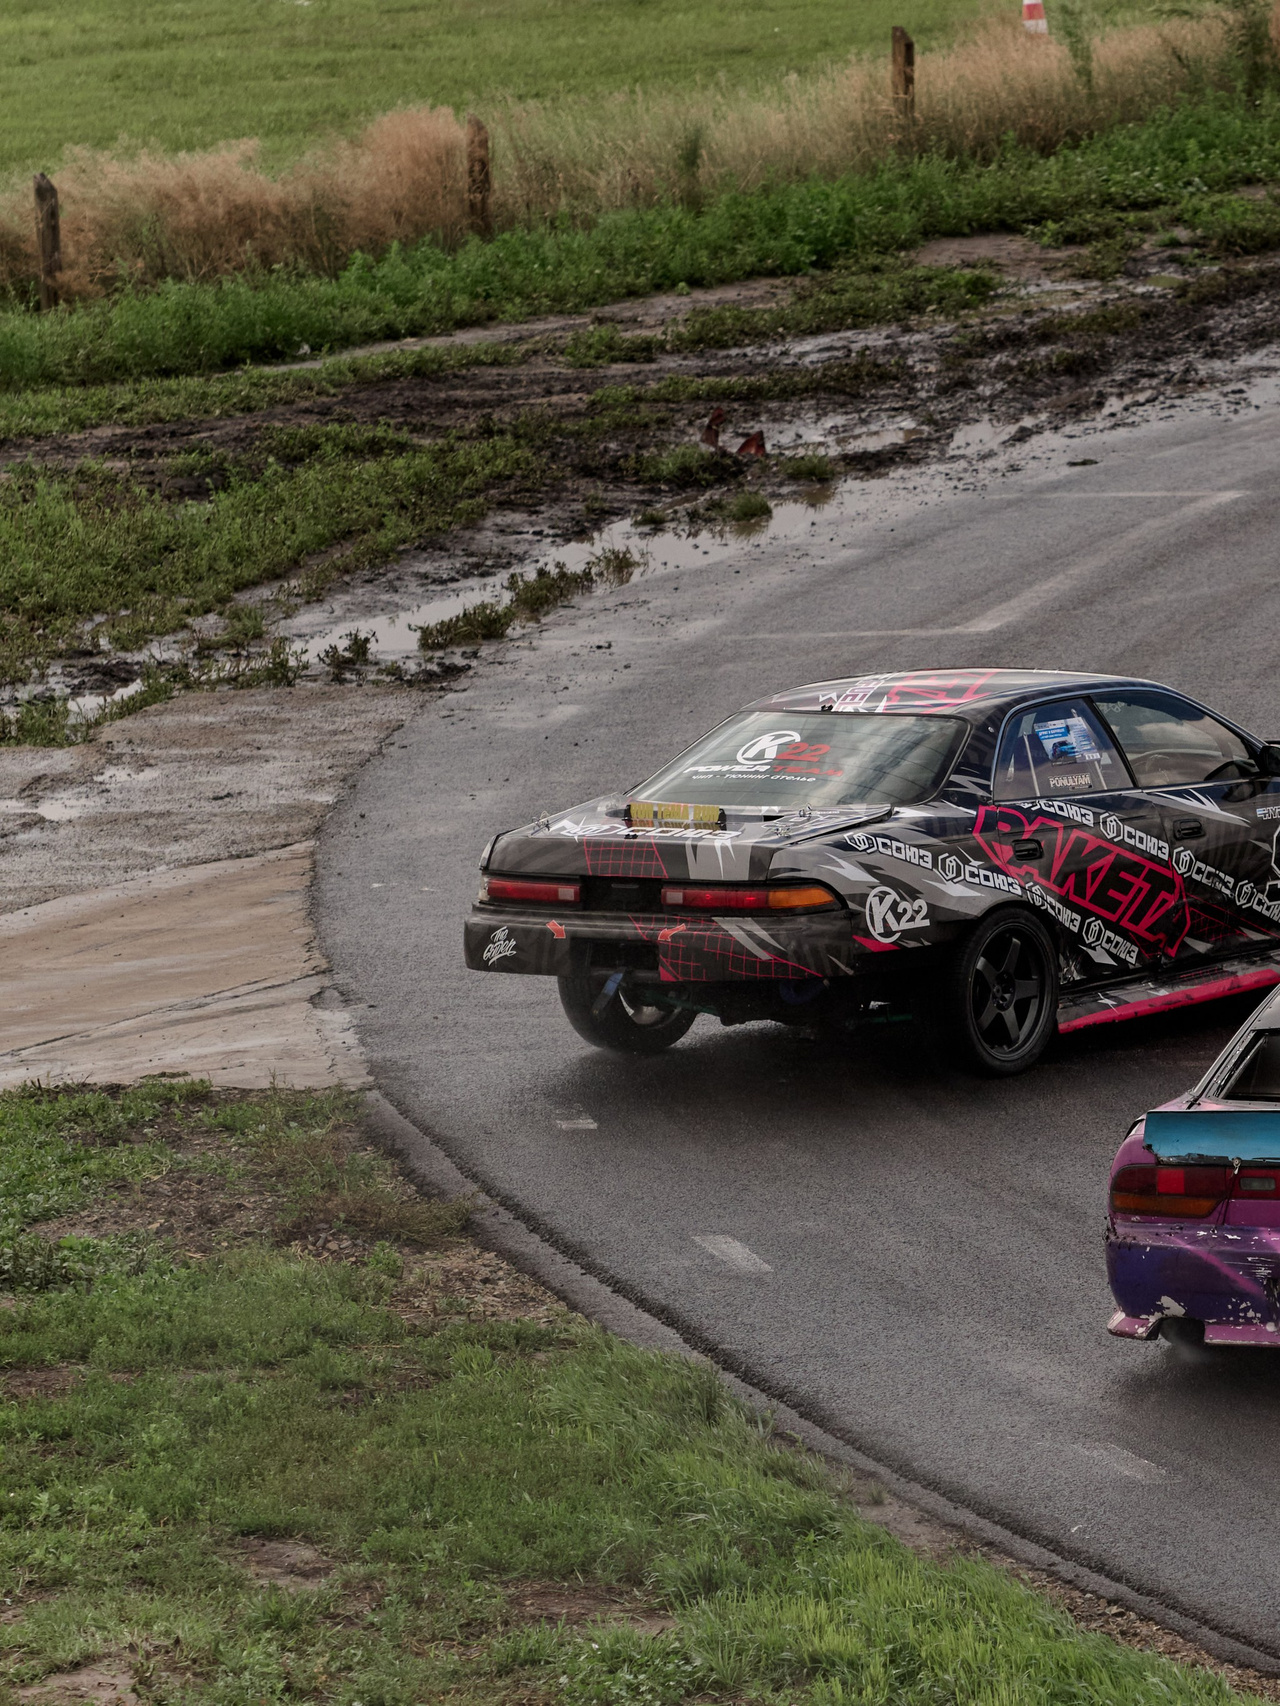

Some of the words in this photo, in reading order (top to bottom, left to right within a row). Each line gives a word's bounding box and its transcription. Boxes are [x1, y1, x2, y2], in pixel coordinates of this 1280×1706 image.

[683, 764, 771, 774] POWER
[772, 764, 844, 777] TEAM
[876, 837, 933, 870] СОЮЗ
[1123, 824, 1170, 861] СОЮЗ
[965, 864, 1022, 896] СОЮЗ
[867, 889, 930, 939] K22
[1102, 931, 1139, 965] СОЮЗ
